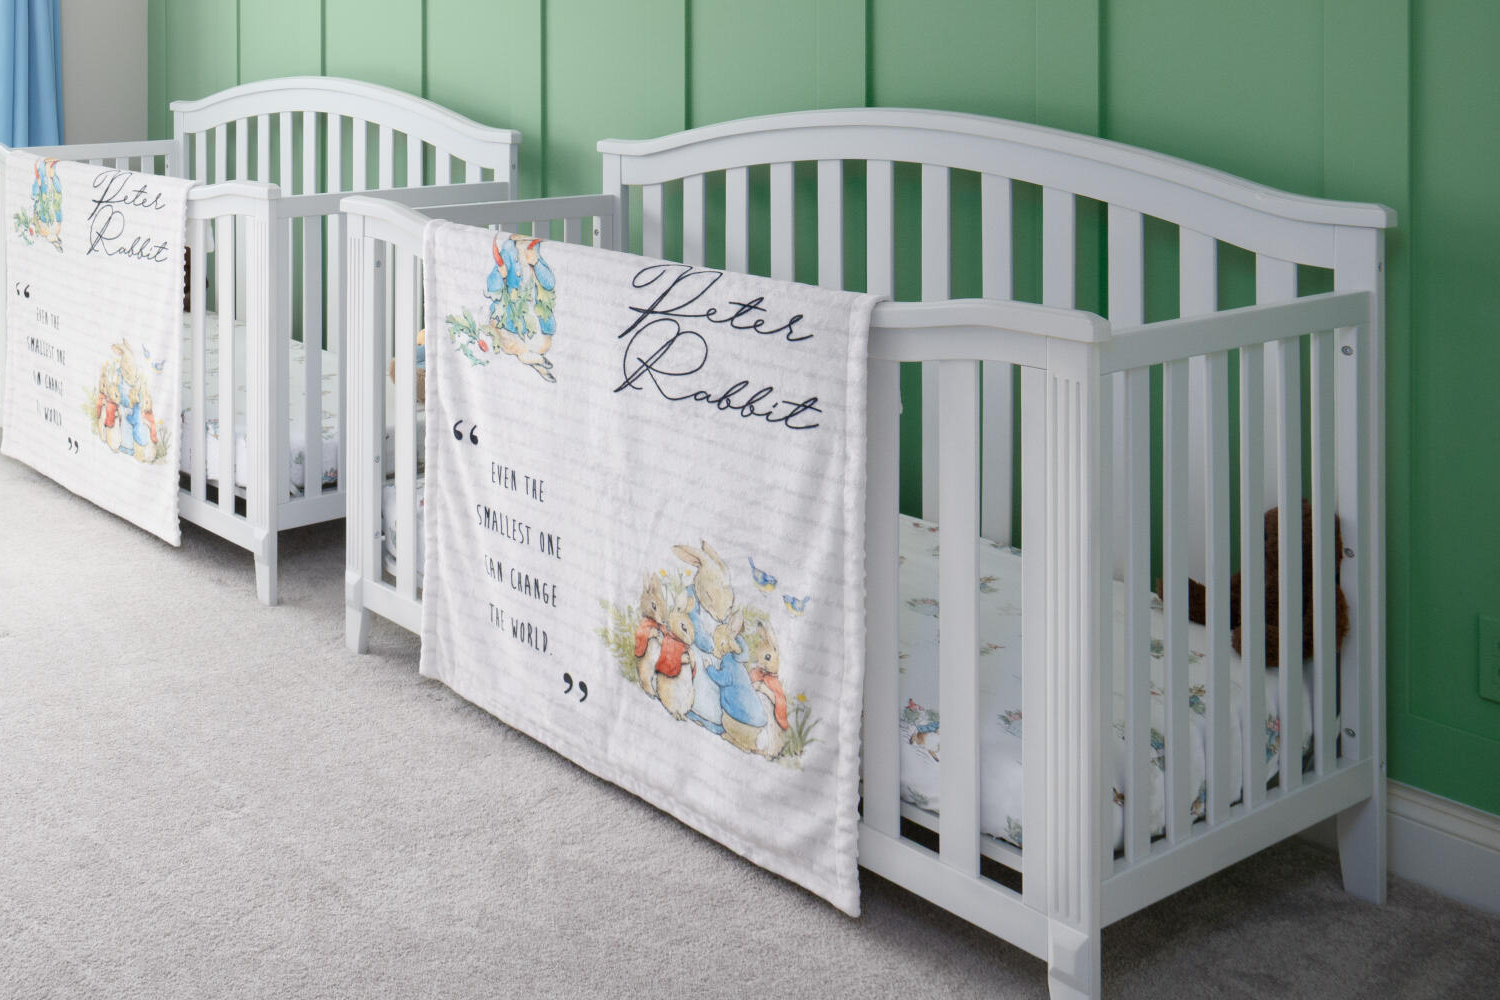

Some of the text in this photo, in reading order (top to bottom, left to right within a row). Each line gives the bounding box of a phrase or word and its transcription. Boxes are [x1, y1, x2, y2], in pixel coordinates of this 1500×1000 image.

[87, 169, 166, 221] Peter
[86, 204, 170, 263] Rabbit
[617, 263, 814, 342] Peter
[613, 317, 823, 430] Rabbit
[491, 461, 544, 503] EVEN THE
[476, 504, 562, 560] SMALLEST ONE
[484, 554, 557, 608] CAN CHANGE
[489, 603, 505, 632] THE
